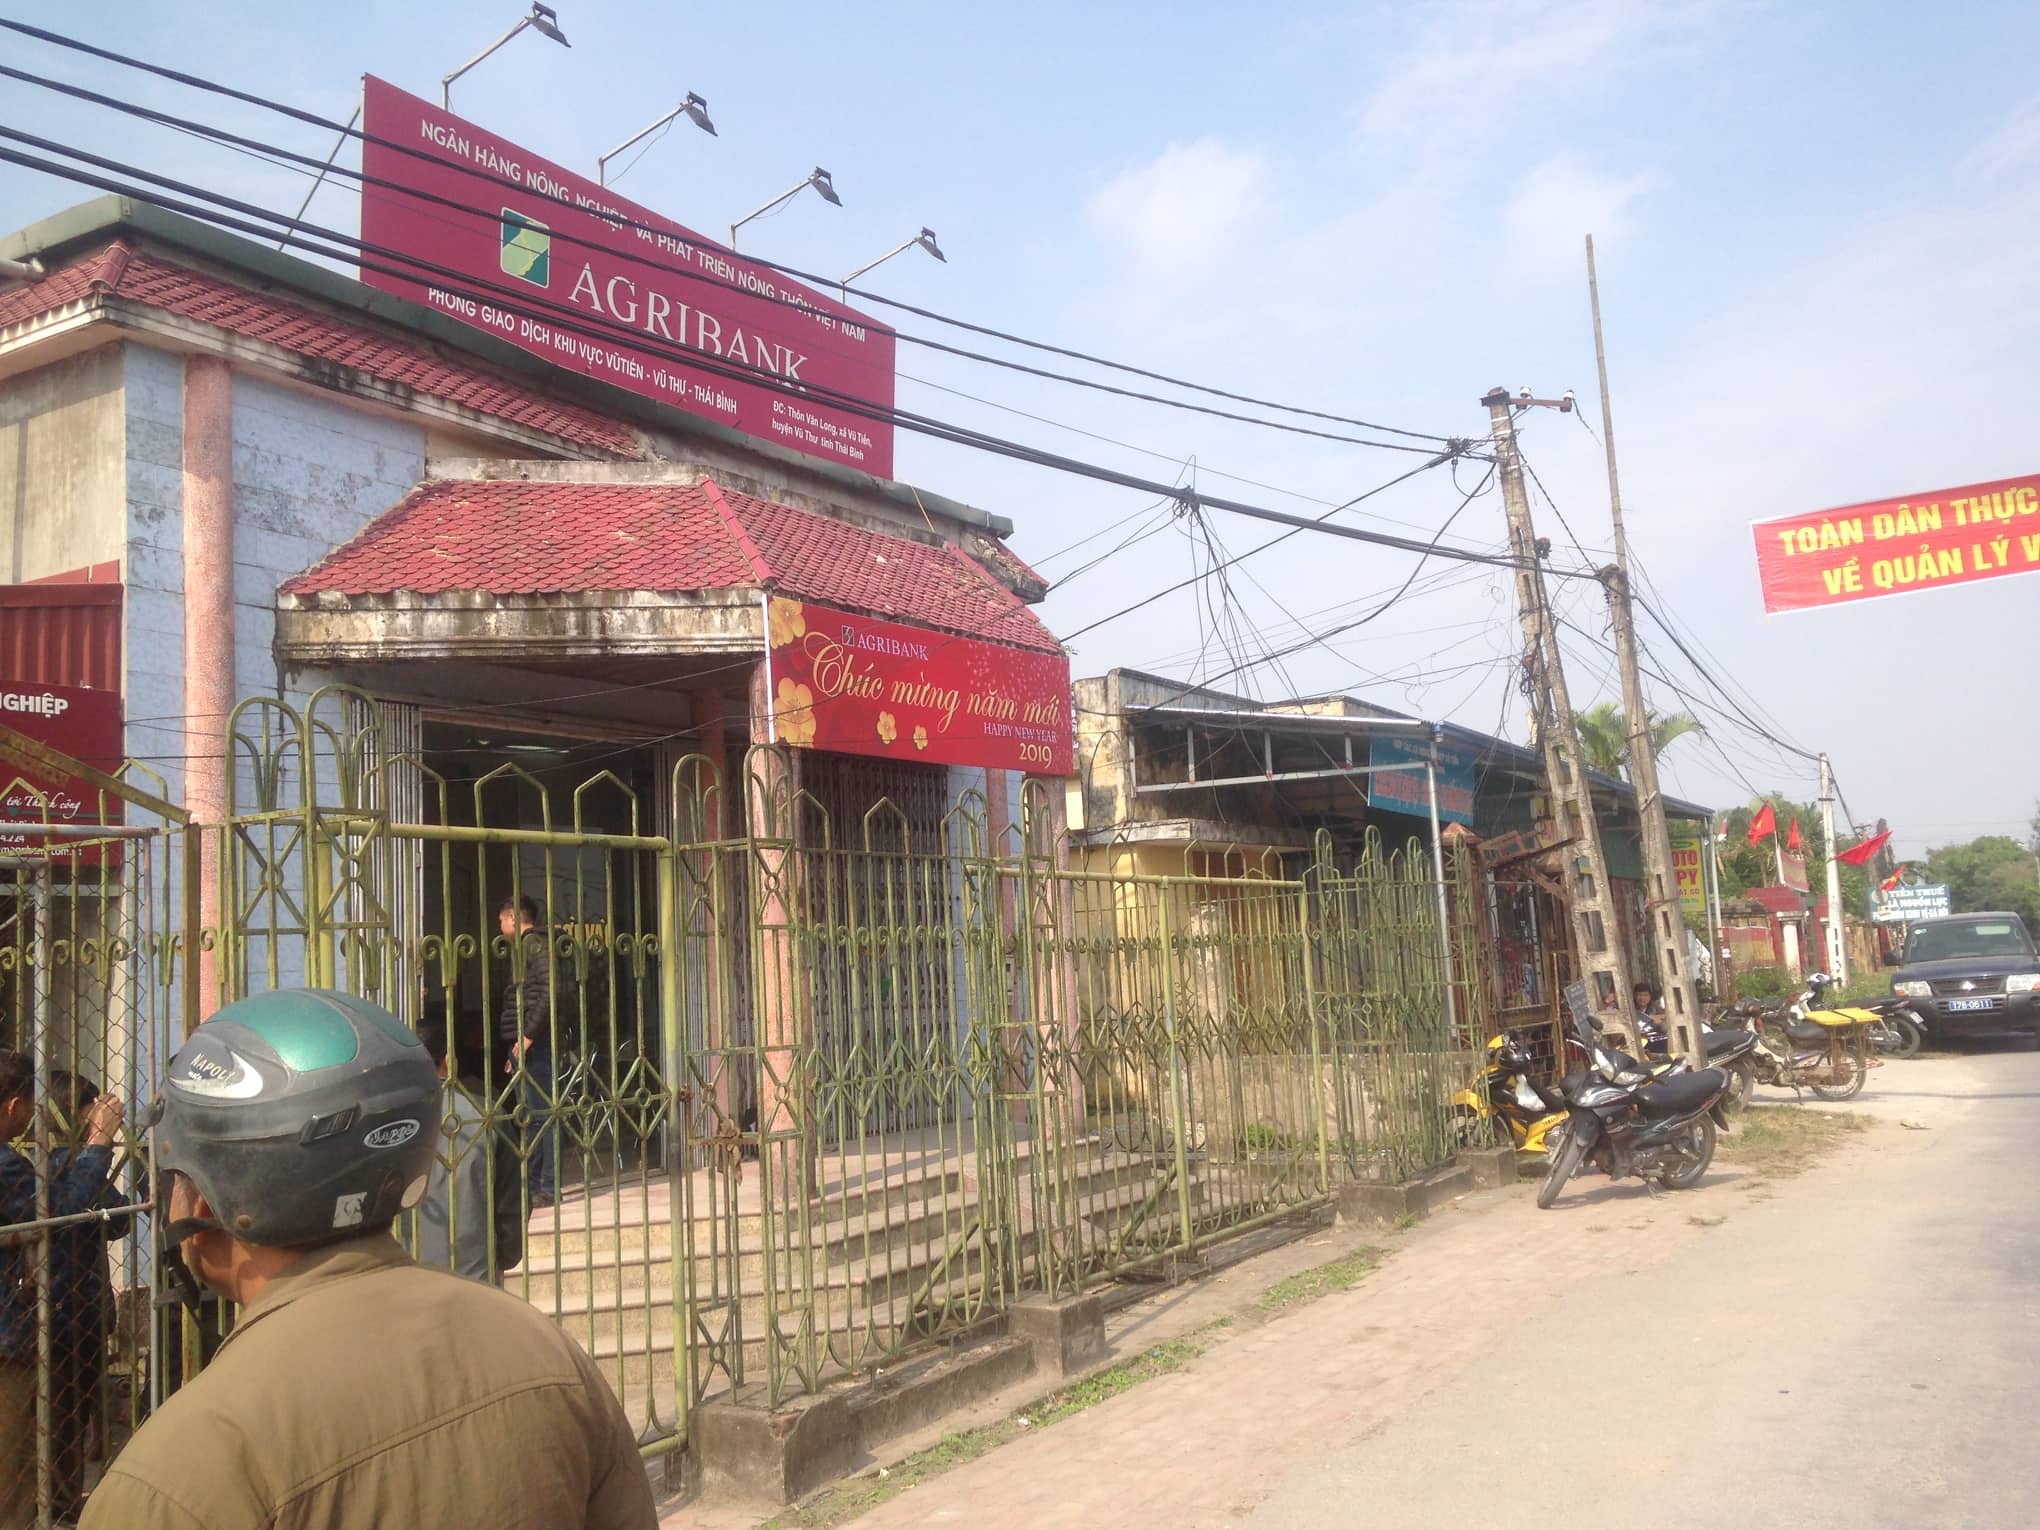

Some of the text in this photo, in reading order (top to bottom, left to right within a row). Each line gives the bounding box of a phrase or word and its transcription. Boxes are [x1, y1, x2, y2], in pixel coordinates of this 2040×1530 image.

[421, 118, 470, 158] NGÂN
[475, 145, 521, 182] HÀNG
[526, 169, 569, 202] NÔNG
[738, 270, 775, 298] NÔNG
[841, 321, 865, 343] NAM
[568, 261, 809, 392] AGRIBANK
[481, 305, 515, 331] GIAO
[521, 319, 550, 344] DỊCH
[554, 332, 576, 355] KHU
[579, 340, 603, 365] VỰC
[652, 368, 667, 389] VŨ
[668, 374, 687, 395] THƯ
[694, 384, 715, 406] THÁI
[716, 391, 737, 415] BÌNH
[772, 417, 793, 437] huyện
[773, 400, 786, 415] ĐC:
[1778, 486, 2039, 557] TOÀN DÂN THỰC
[1823, 555, 1863, 596] VỀ
[1872, 543, 1963, 589] QUẢN
[1972, 533, 2010, 571] LÝ
[803, 631, 884, 698] Chúc
[967, 689, 1018, 722] năm
[858, 632, 928, 661] AGRIBANK
[983, 721, 1057, 743] HAPPY NEW YEAR
[1019, 742, 1053, 769] 2019
